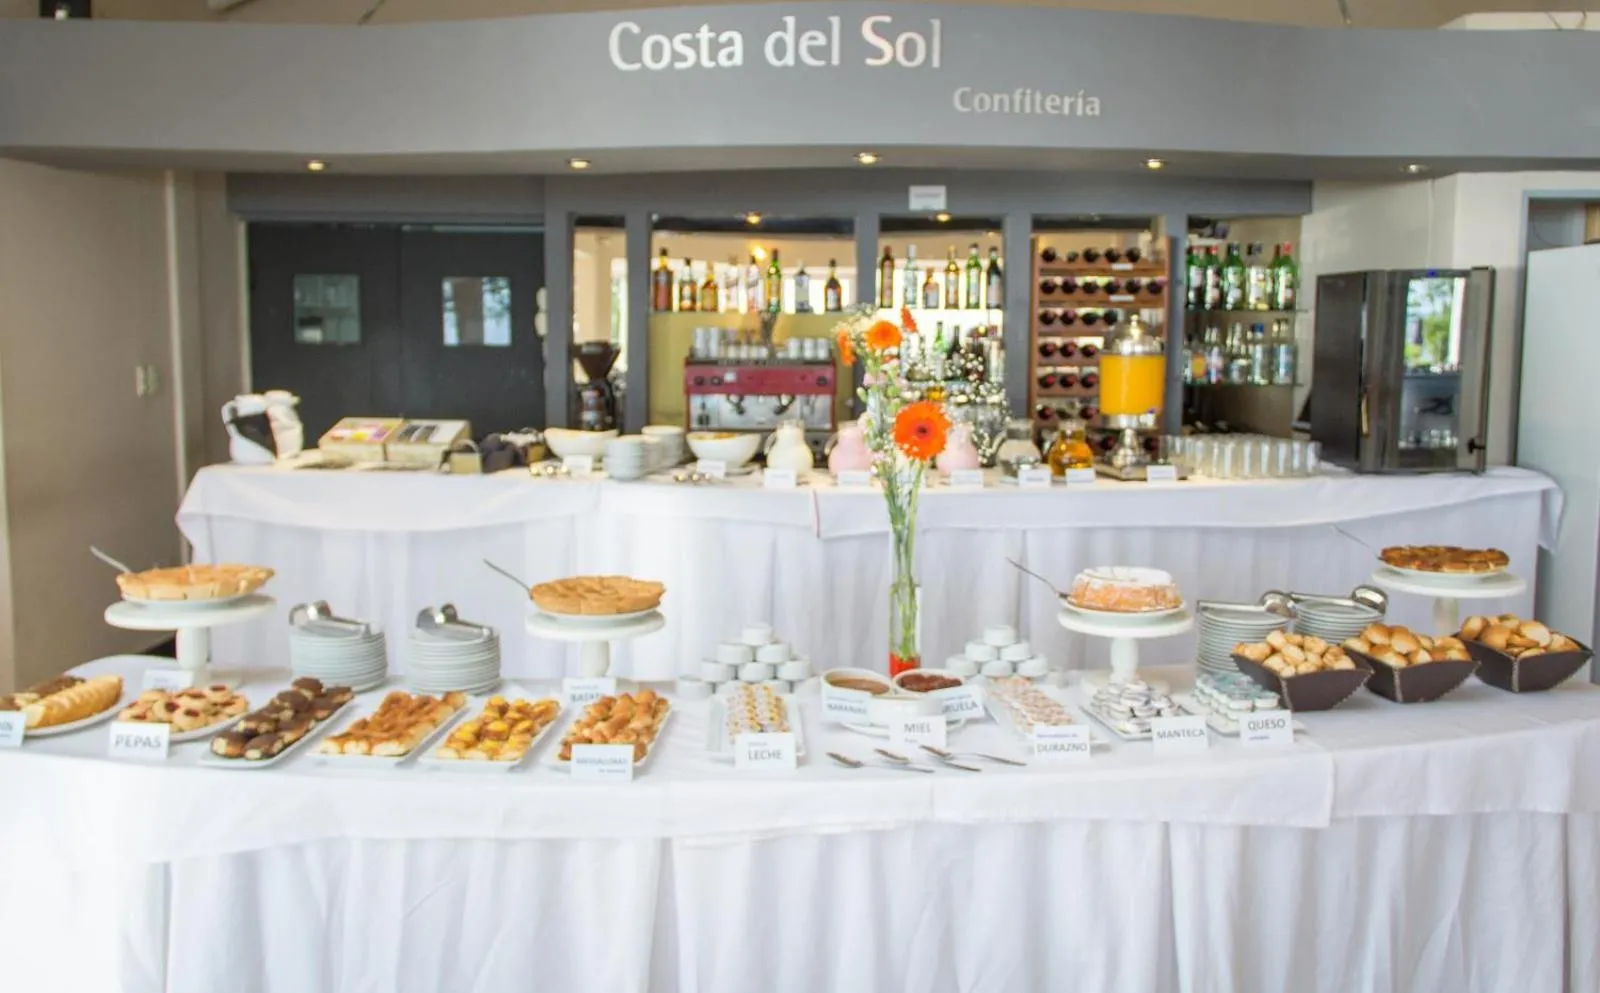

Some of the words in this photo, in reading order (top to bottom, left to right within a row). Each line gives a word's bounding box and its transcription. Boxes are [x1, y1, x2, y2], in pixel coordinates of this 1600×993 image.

[608, 20, 743, 71] Costa
[764, 16, 841, 67] del
[862, 15, 941, 68] Sol
[952, 86, 1101, 117] Confitería
[904, 722, 932, 734] MIEL
[1247, 718, 1286, 731] QUESO
[1156, 727, 1205, 740] MANTECA
[114, 734, 162, 748] PEPAS
[1036, 742, 1088, 753] DURAZNO
[747, 749, 783, 761] LECHE
